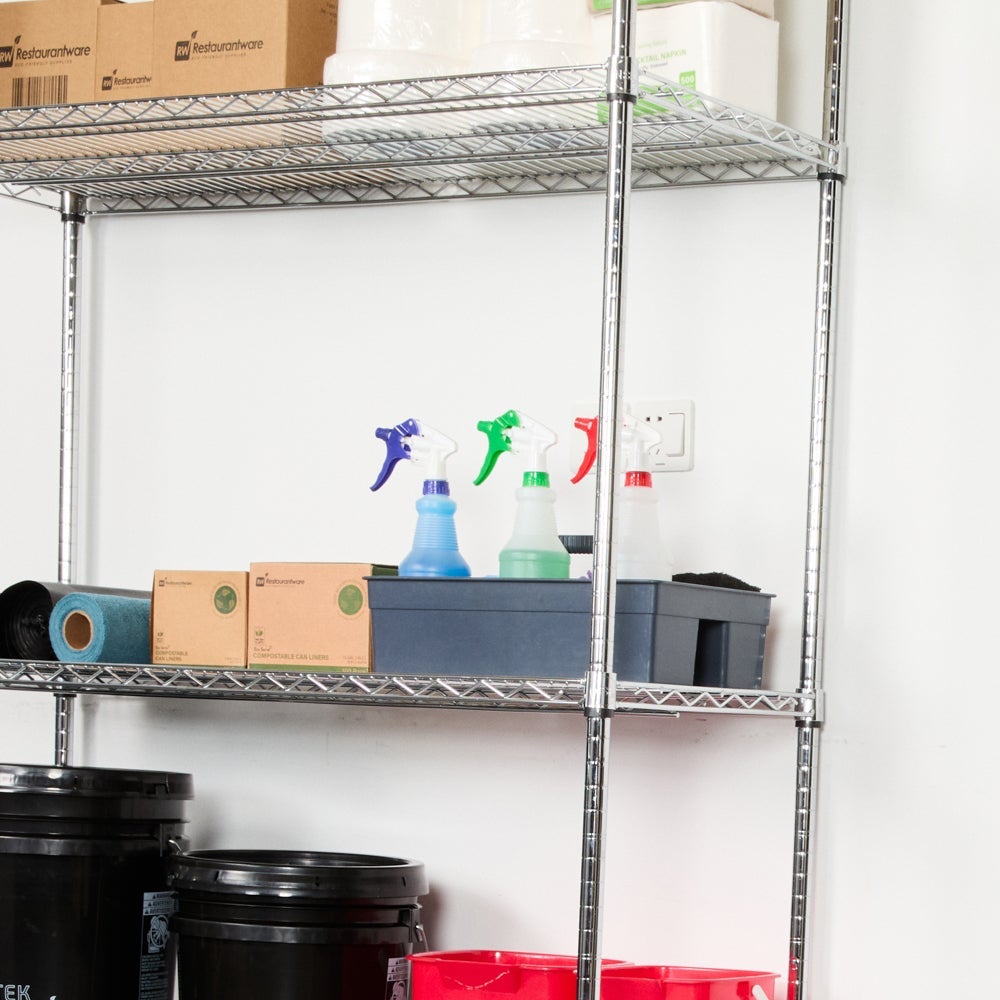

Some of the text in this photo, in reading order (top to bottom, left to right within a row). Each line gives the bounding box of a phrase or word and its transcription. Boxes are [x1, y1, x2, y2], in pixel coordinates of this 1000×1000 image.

[15, 45, 91, 60] Restaurantware
[192, 39, 264, 54] Restaurantware
[660, 48, 686, 59] NAPKIN
